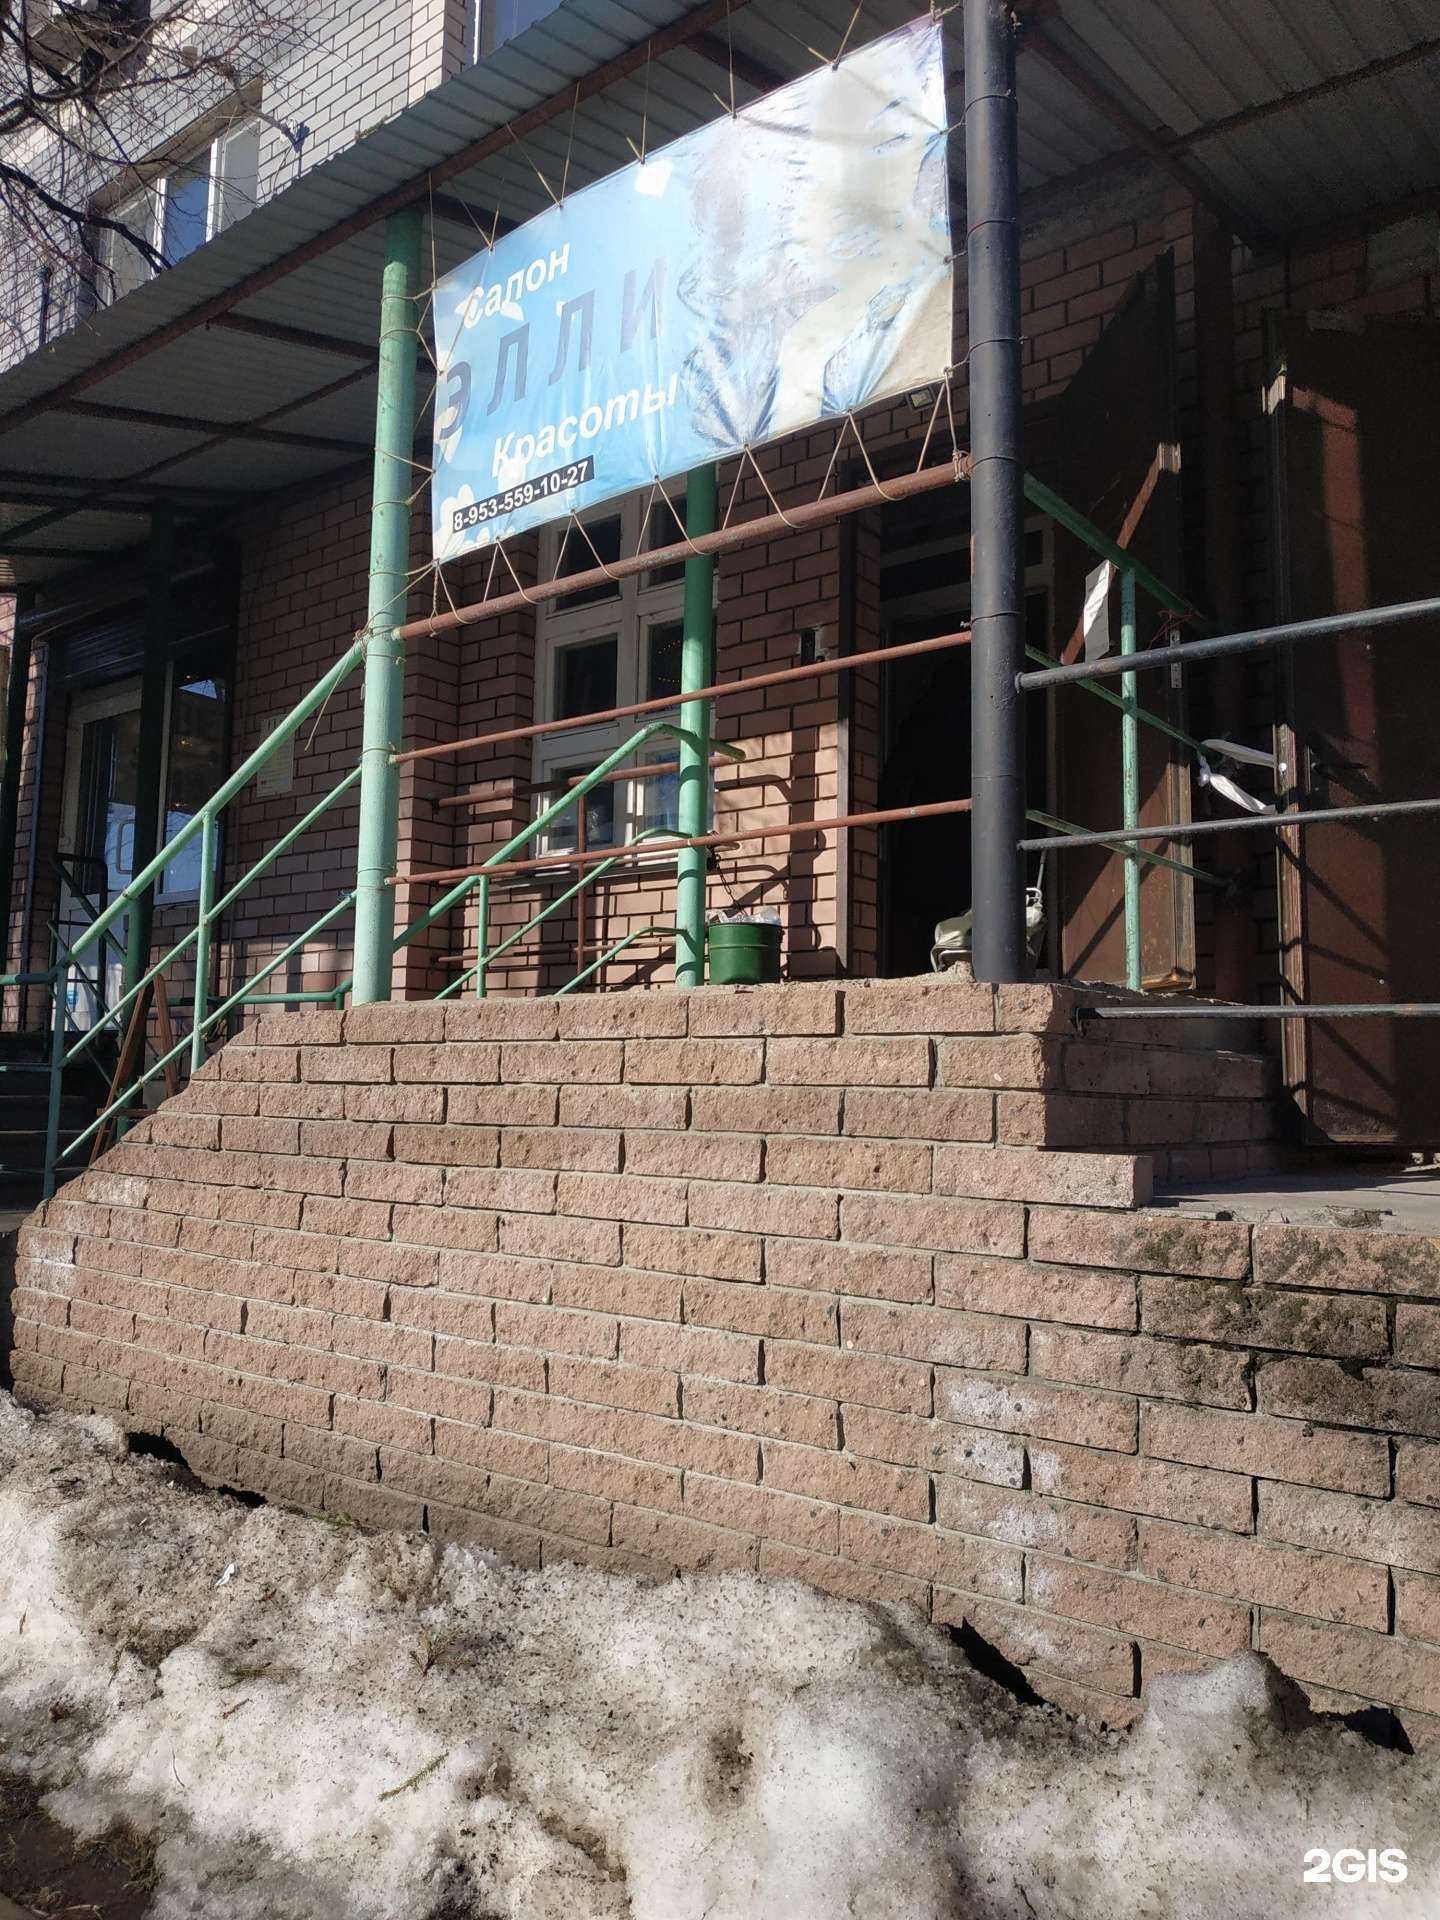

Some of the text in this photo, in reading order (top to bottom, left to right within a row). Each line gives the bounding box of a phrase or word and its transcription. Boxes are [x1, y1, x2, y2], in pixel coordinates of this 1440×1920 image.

[462, 243, 570, 329] Салон
[438, 257, 667, 441] ЭЛЛИ
[491, 373, 679, 479] Красоты
[453, 461, 590, 531] 8-953-559-10-27
